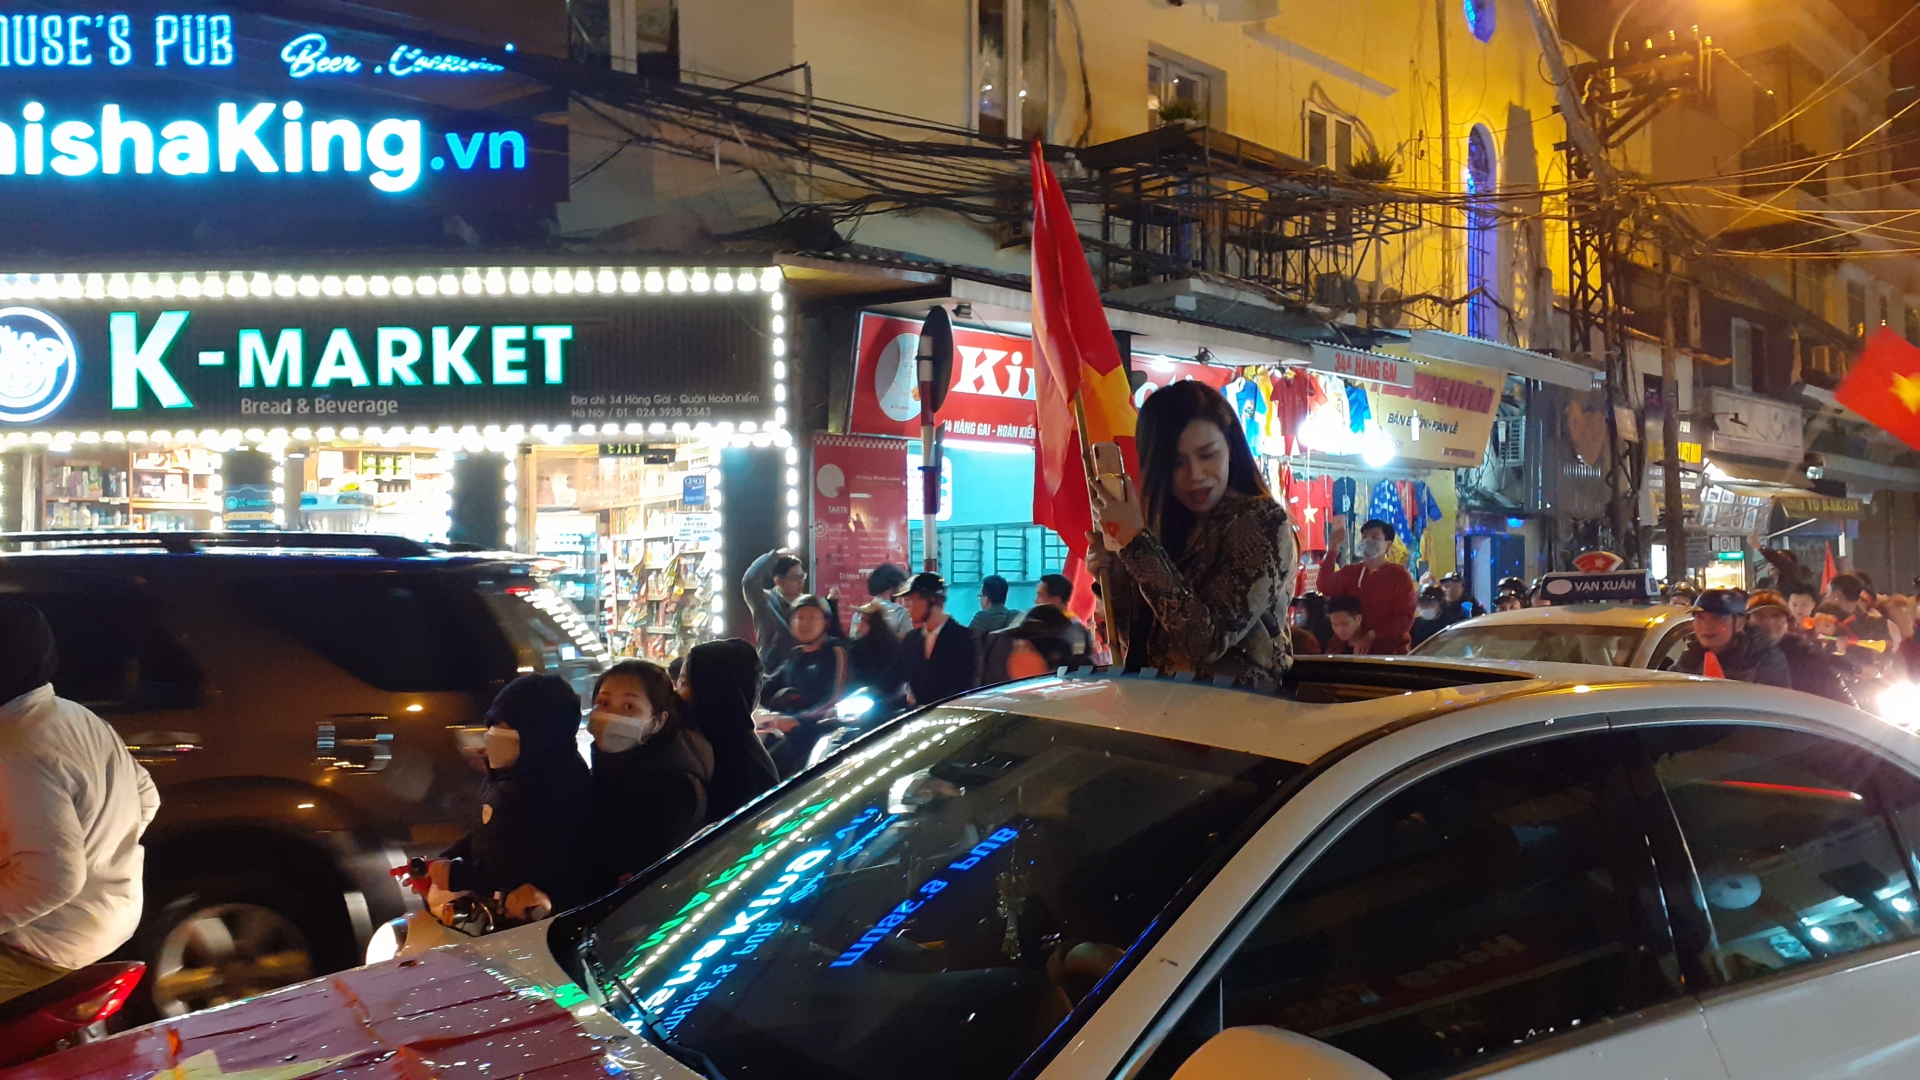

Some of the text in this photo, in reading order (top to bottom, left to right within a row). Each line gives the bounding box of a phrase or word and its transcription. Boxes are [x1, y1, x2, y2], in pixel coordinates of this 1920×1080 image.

[154, 14, 235, 67] PUB
[281, 33, 361, 78] Beer
[1382, 361, 1398, 383] GAI
[241, 398, 399, 416] Bread & Beverage
[609, 395, 622, 404] 34
[735, 391, 759, 403] Kiếm
[571, 408, 586, 418] Hà
[636, 407, 656, 417] 024
[659, 407, 683, 417] 3938
[686, 406, 711, 417] 2343
[953, 418, 976, 435] HÀNG
[977, 423, 992, 437] GAI
[997, 423, 1018, 438] HOÀN
